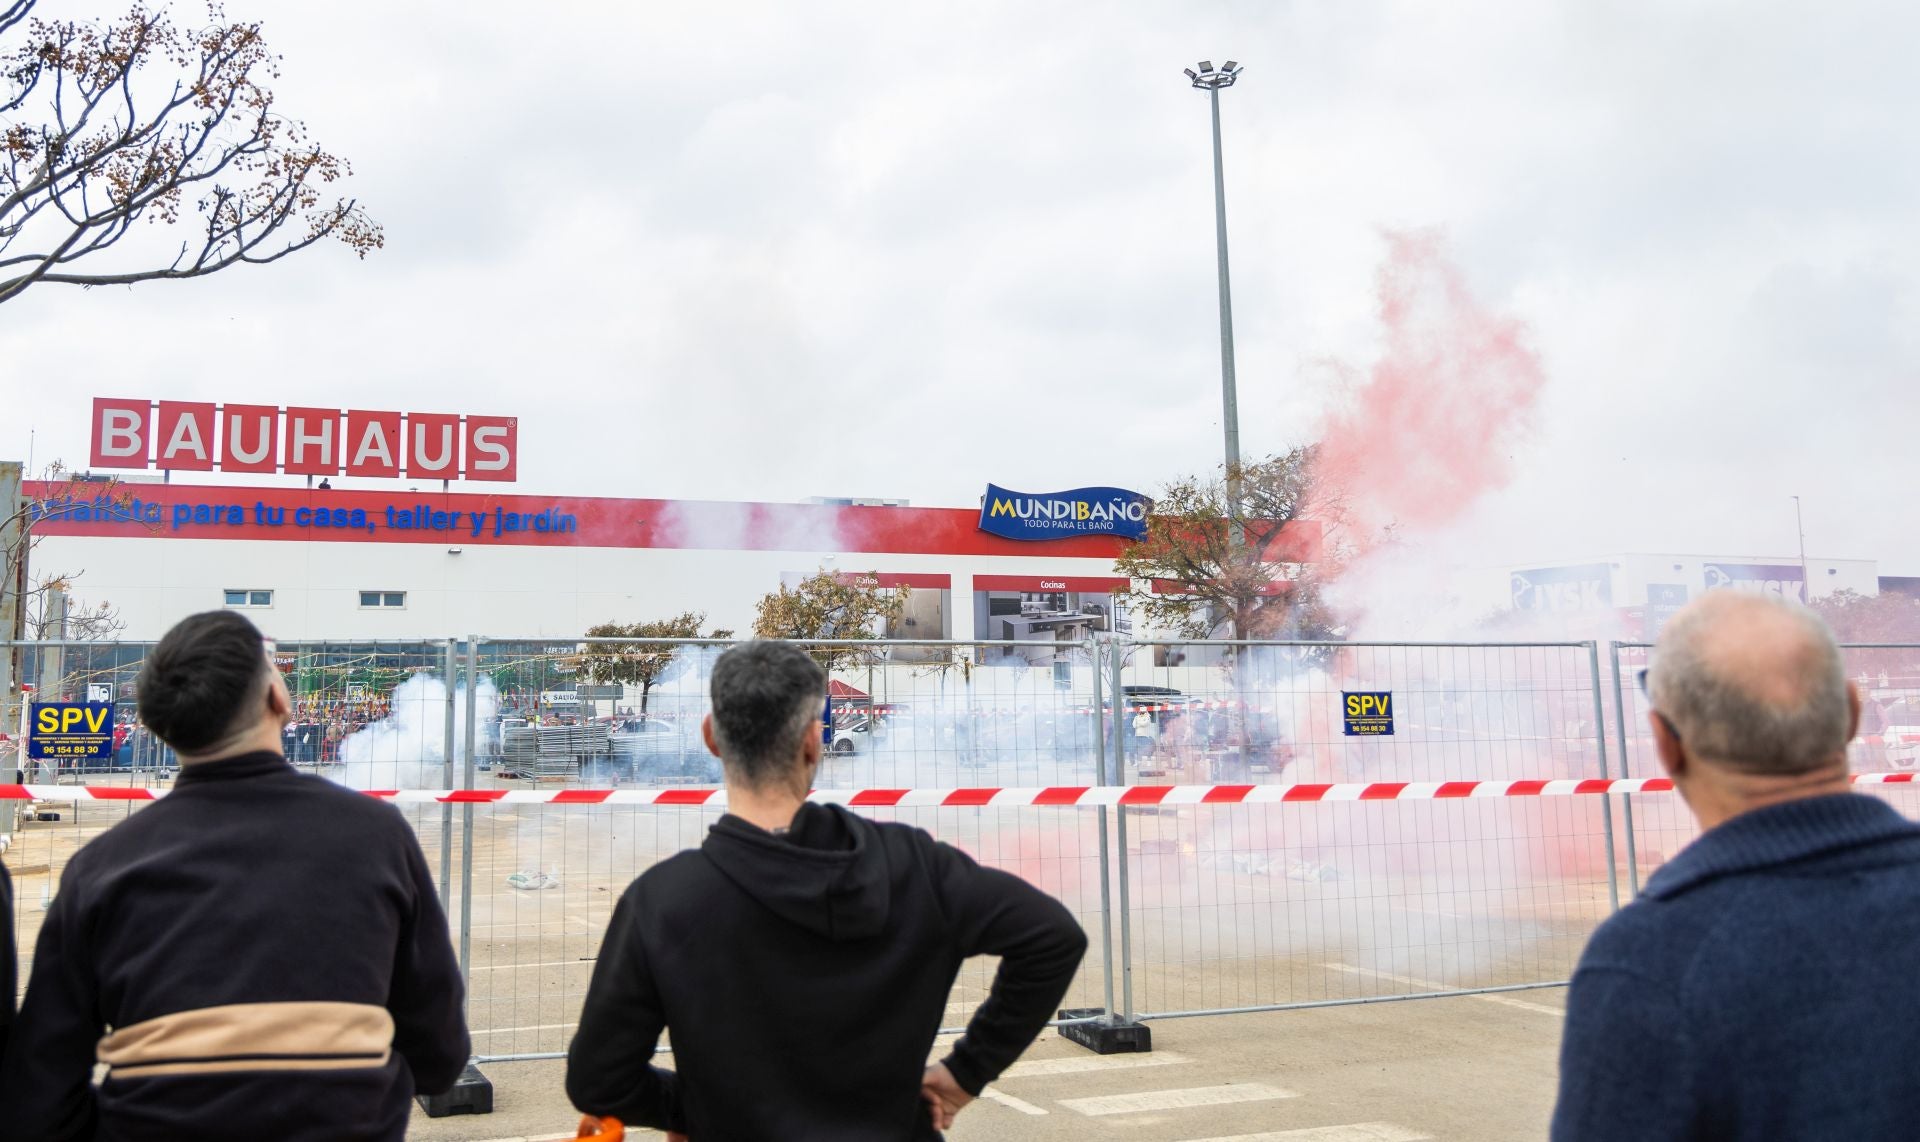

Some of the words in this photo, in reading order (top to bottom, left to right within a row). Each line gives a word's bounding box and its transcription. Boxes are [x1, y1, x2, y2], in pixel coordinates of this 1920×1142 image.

[100, 408, 510, 471] BAUHAUS
[172, 502, 244, 530] para
[254, 501, 285, 526] tu
[294, 506, 376, 534] casa,
[385, 504, 461, 529] taller
[470, 511, 487, 537] y
[494, 506, 578, 538] jardín
[990, 497, 1146, 522] MUNDIBAÑO
[1024, 519, 1050, 528] TODO
[1052, 520, 1075, 529] PARA
[1077, 521, 1087, 530] EL
[1089, 519, 1114, 530] BAÑO
[1040, 580, 1066, 589] Cocinas
[1347, 695, 1389, 716] SPV
[37, 707, 109, 733] SPV
[43, 745, 55, 754] 96
[57, 745, 71, 754] 154
[73, 745, 85, 754] 88
[87, 745, 99, 754] 30
